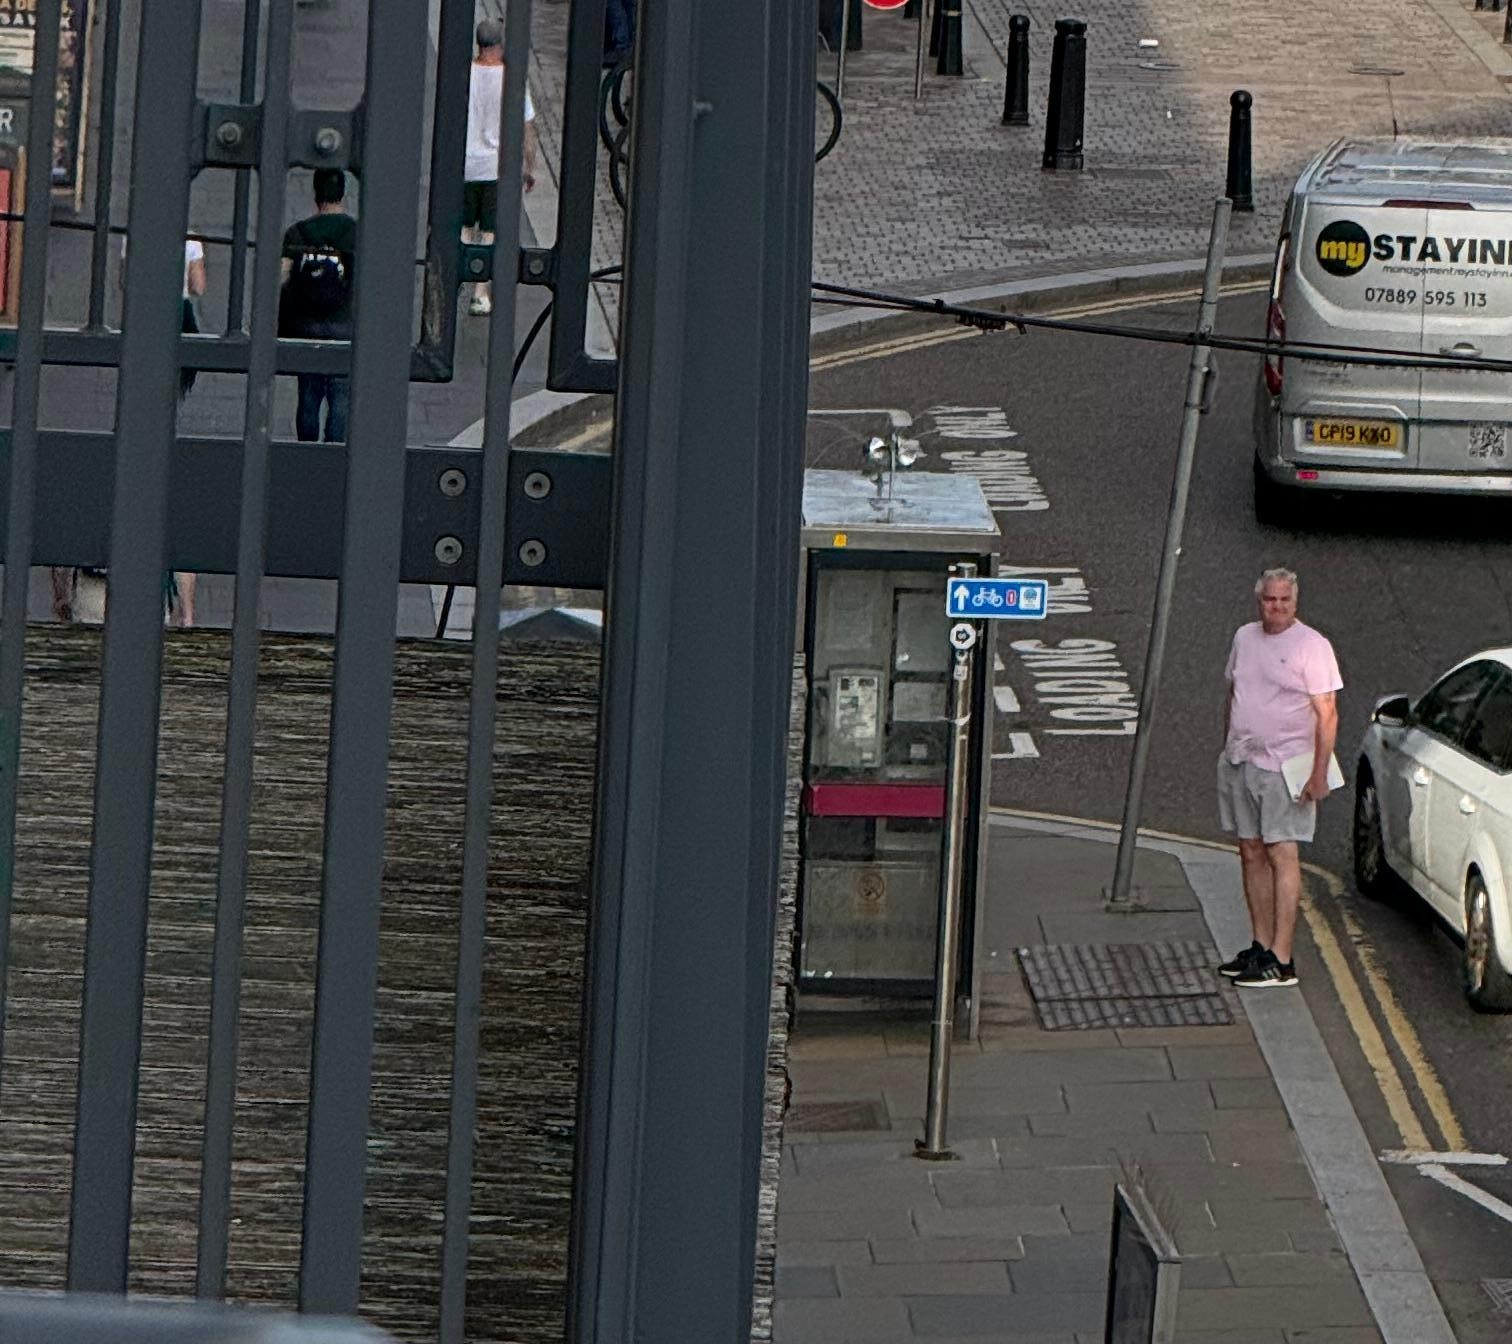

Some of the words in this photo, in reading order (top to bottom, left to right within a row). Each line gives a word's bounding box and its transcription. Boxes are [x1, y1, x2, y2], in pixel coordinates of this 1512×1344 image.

[1319, 239, 1366, 268] my
[1365, 287, 1417, 305] 07889
[1424, 290, 1456, 306] 595
[1464, 291, 1487, 308] 113
[1009, 638, 1139, 736] LOADING
